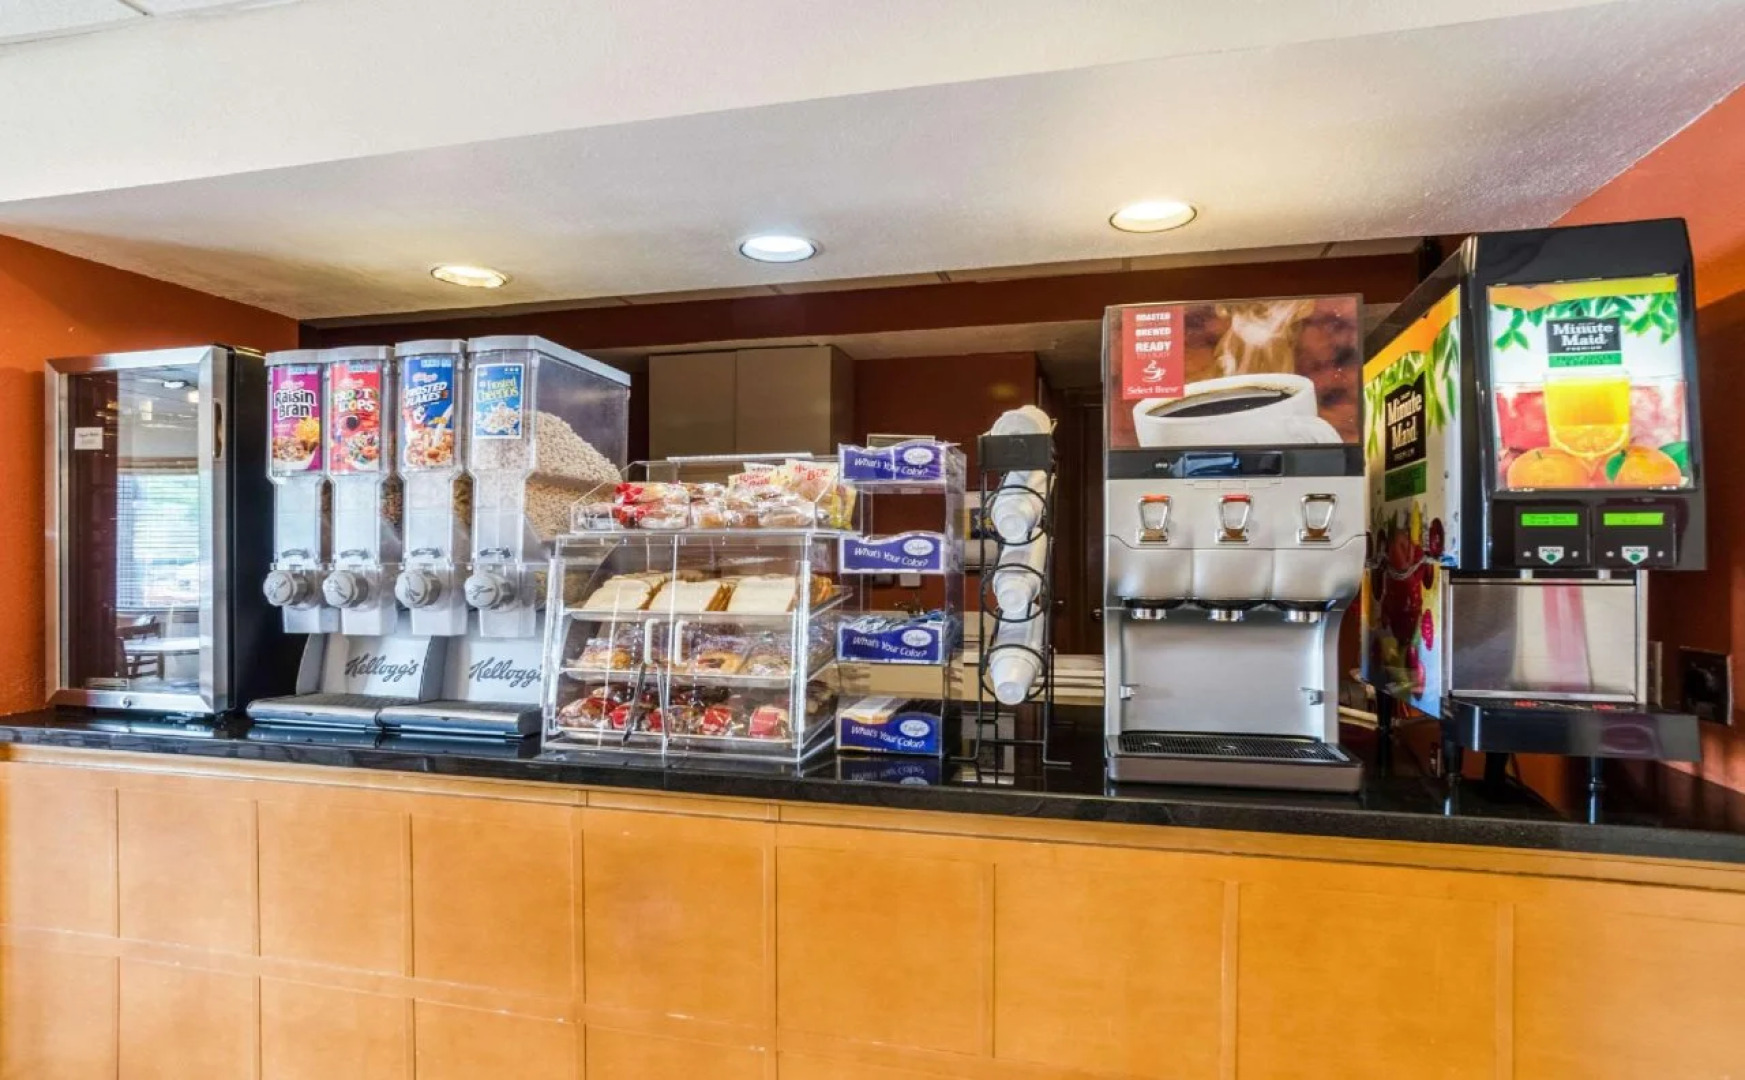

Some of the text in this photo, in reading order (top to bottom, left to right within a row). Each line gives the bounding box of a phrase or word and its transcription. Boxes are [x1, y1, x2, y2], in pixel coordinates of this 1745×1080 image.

[1135, 312, 1171, 321] ROASTED
[1135, 327, 1171, 337] BREWED
[1553, 322, 1614, 336] Minute
[1135, 341, 1172, 353] READY
[1561, 333, 1607, 347] Maid
[275, 389, 316, 404] Raisin
[1127, 385, 1178, 395] Select Brew
[278, 401, 310, 419] Bran
[1388, 390, 1422, 427] Minute
[1392, 416, 1418, 450] Maid
[855, 457, 880, 468] What's
[901, 465, 928, 476] Color?
[854, 547, 928, 567] What's Your Color?
[852, 635, 927, 657] What's Your Color?
[344, 652, 419, 683] Kellogg's
[851, 725, 925, 748] What's Your Color?
